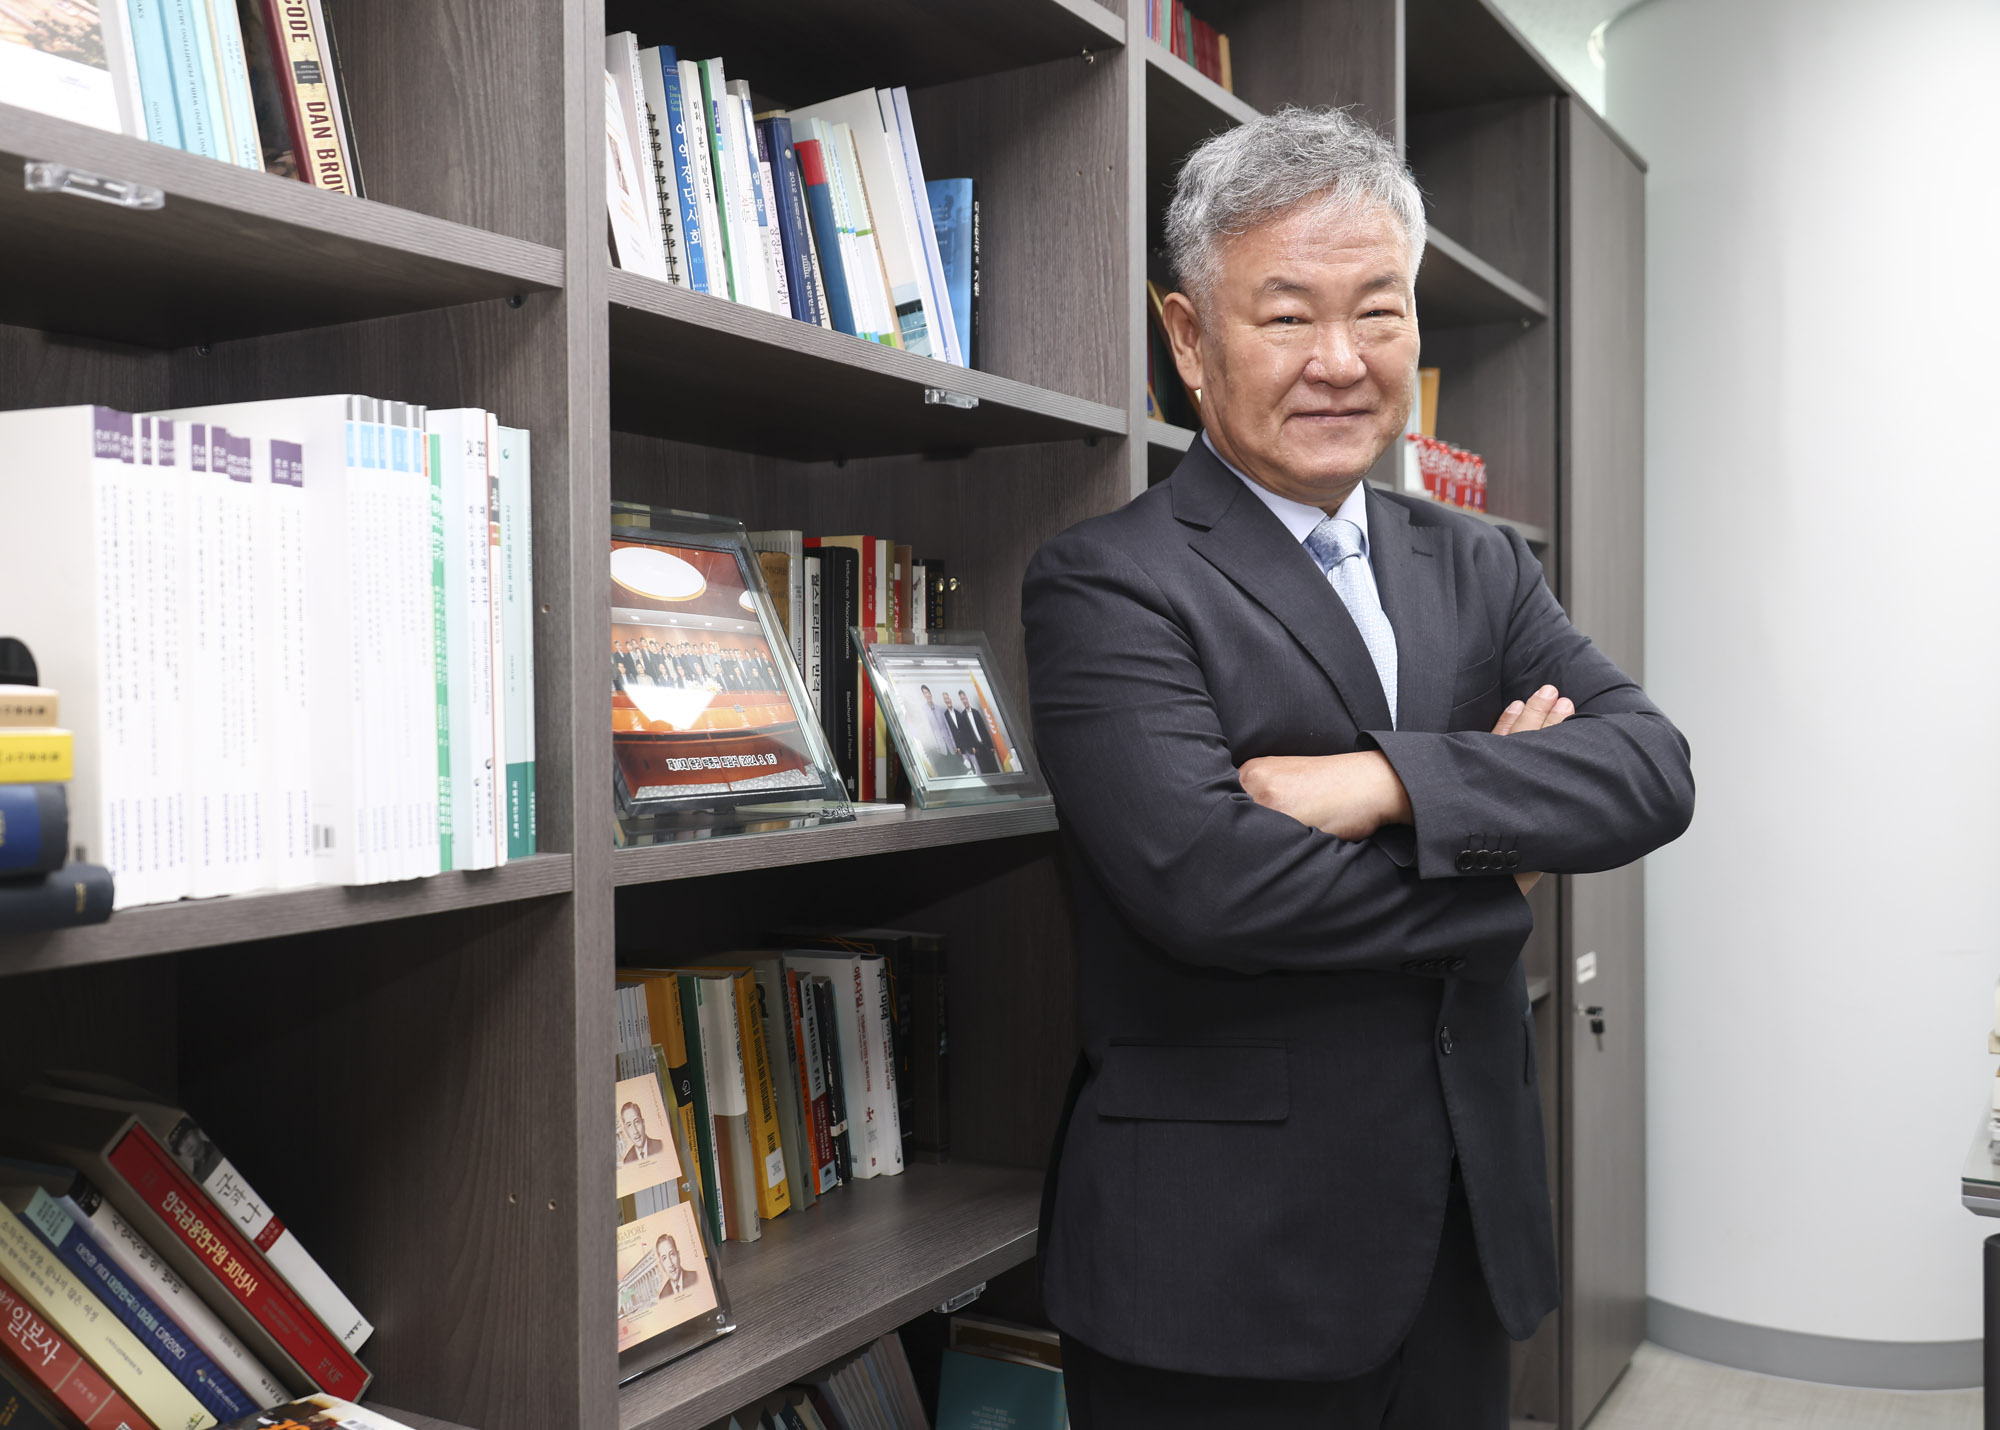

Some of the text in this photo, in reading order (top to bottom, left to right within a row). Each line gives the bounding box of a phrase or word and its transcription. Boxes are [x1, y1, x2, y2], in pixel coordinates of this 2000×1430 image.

[306, 101, 333, 139] DAN
[692, 100, 701, 121] 미리
[699, 154, 711, 204] 대한민국
[788, 171, 798, 193] 2012
[812, 572, 820, 692] 월스트리트의 반격
[877, 966, 890, 1021] 부의 미래
[804, 982, 821, 1091] WHY NATIONS FAIL
[757, 1079, 773, 1123] BLOCKCHAINS
[159, 1189, 231, 1266] 한국금융연구원
[220, 1256, 259, 1296] 30년사
[43, 1263, 70, 1289] 끝나지
[80, 1302, 100, 1321] 여정
[73, 1242, 98, 1267] 대전환
[92, 1262, 111, 1281] 시대
[104, 1274, 142, 1313] 대한민국의
[135, 1306, 160, 1331] 미래를
[153, 1325, 188, 1360] 디자인하다
[8, 1306, 62, 1367] 일본사
[324, 1365, 343, 1385] KIF
